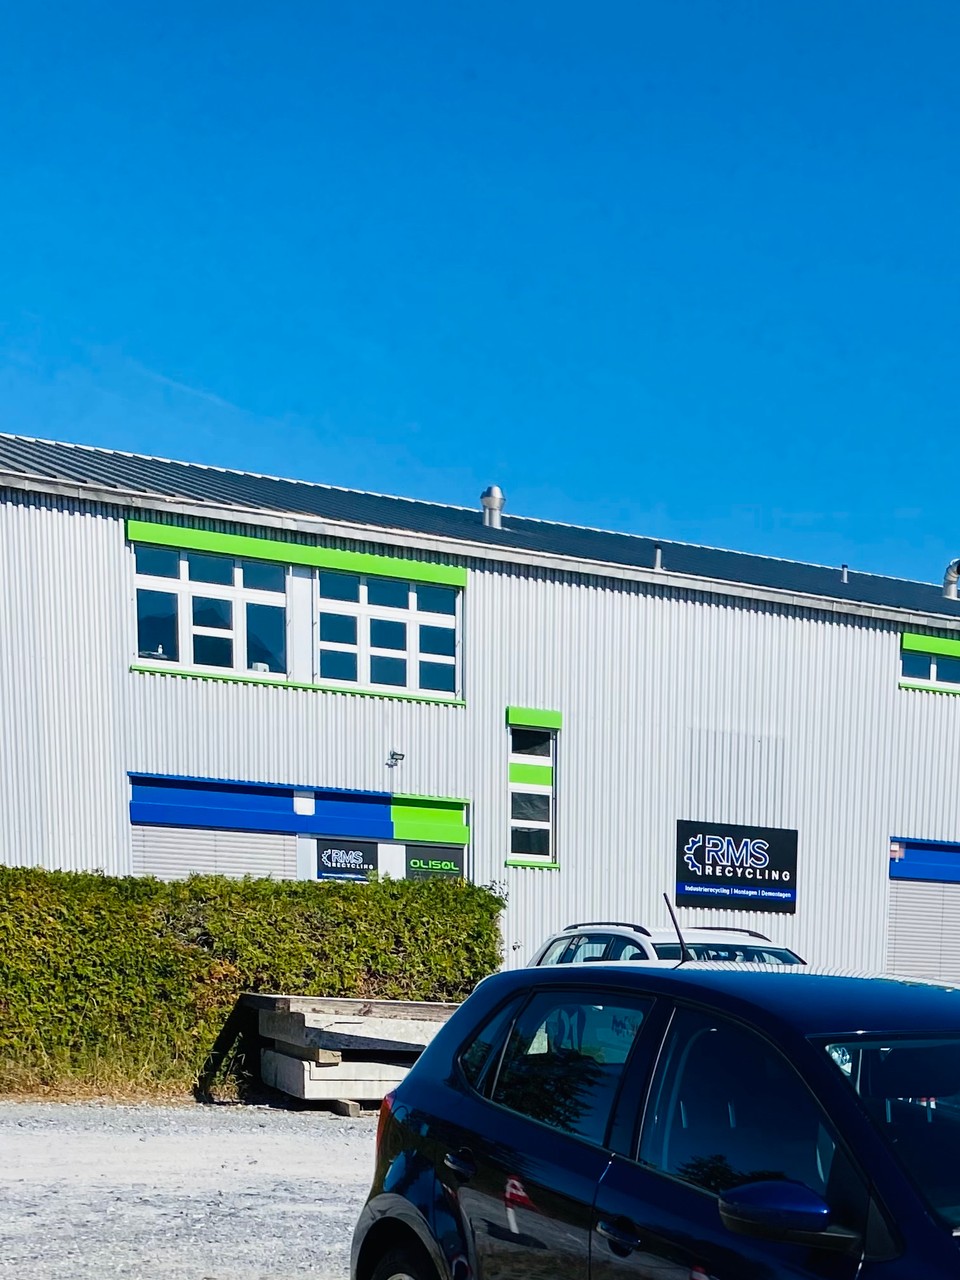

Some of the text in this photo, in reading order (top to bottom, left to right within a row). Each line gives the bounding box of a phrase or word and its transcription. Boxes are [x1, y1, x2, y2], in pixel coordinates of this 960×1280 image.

[332, 849, 363, 864] RMS
[705, 834, 769, 868] RMS
[410, 859, 459, 869] OLISOL
[705, 865, 790, 881] RECYCLING
